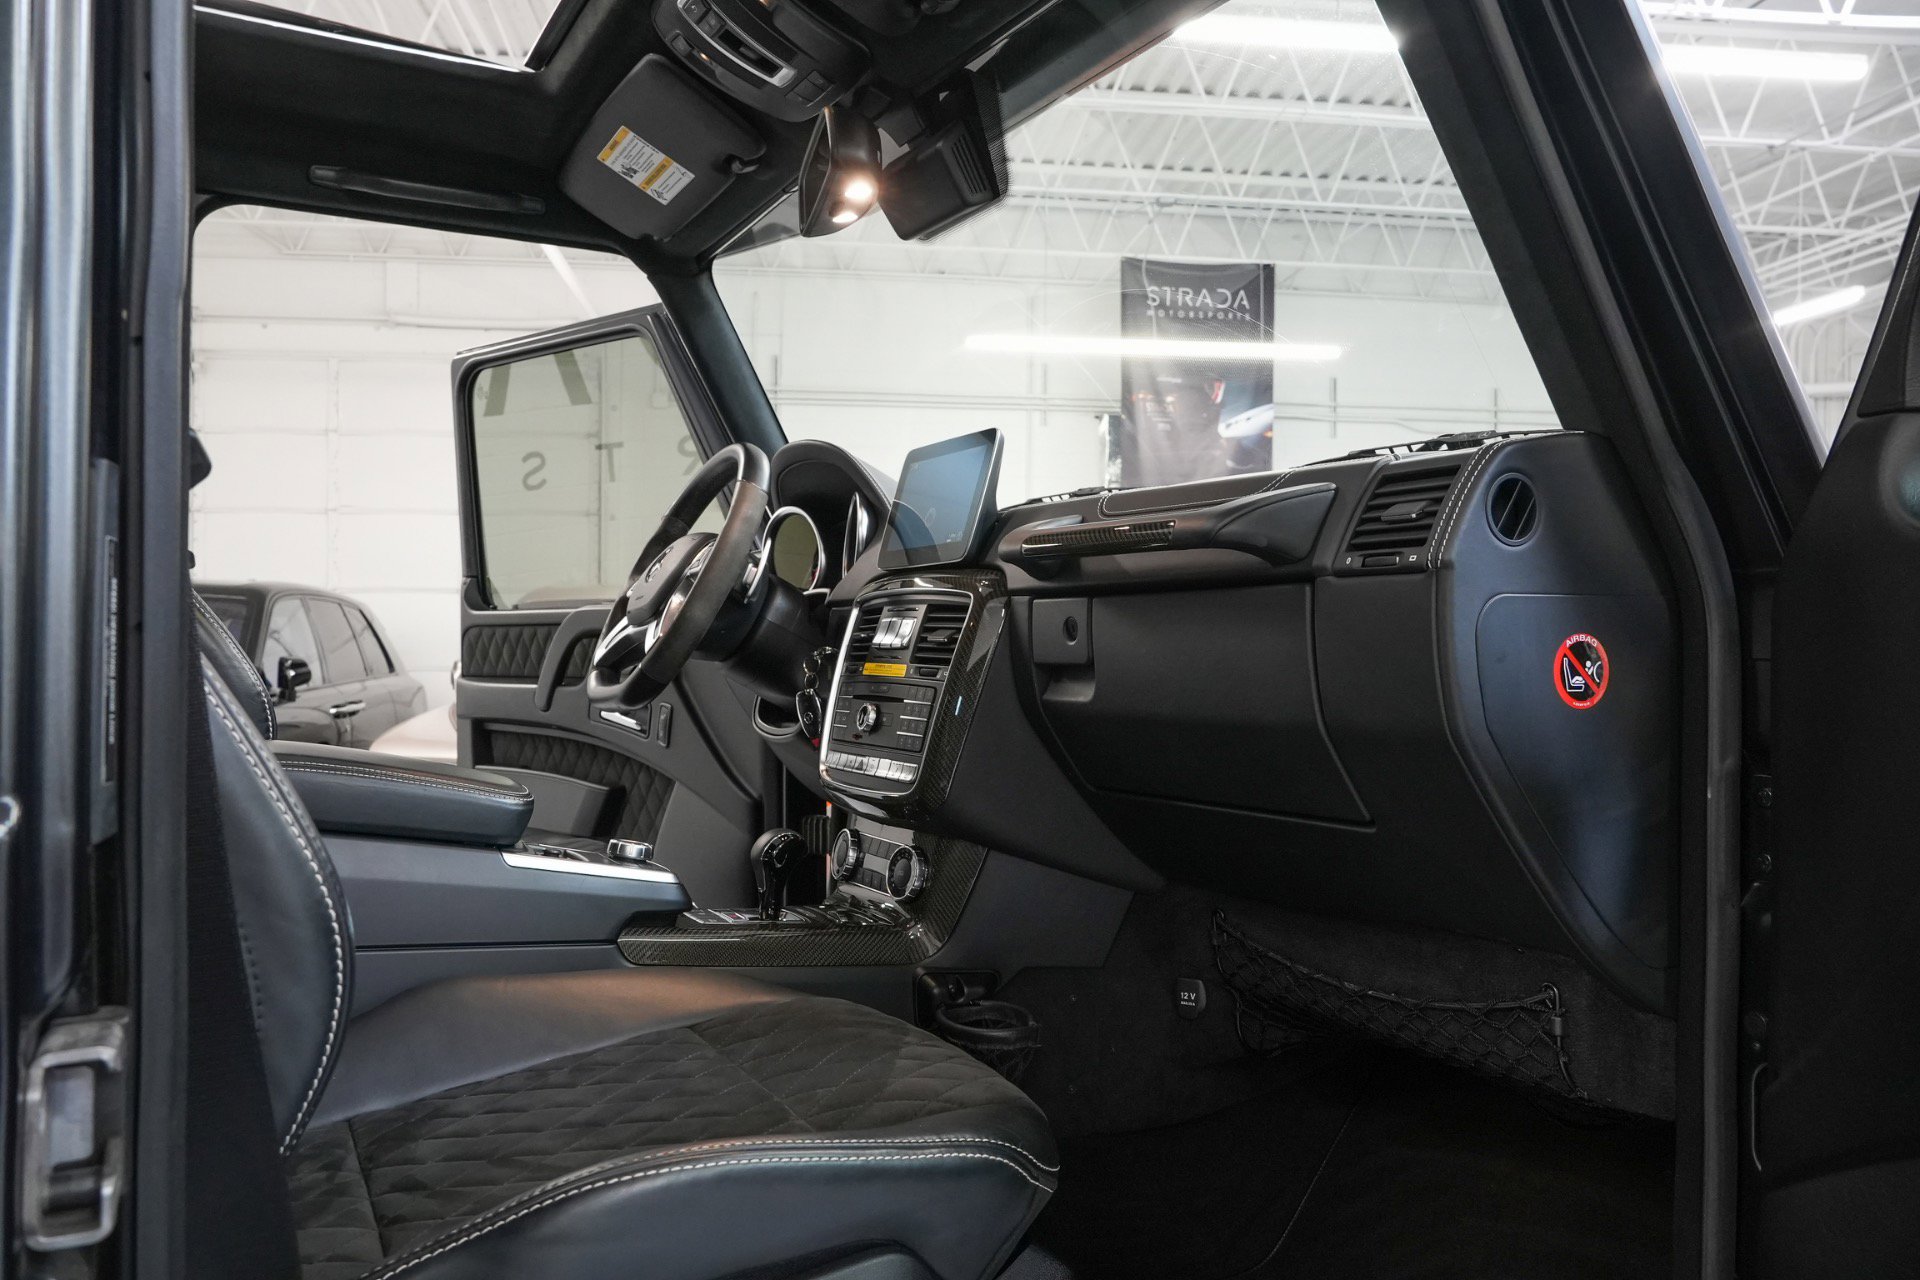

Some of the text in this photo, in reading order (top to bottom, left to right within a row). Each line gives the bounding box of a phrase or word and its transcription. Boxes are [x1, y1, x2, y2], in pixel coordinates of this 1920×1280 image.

[1146, 285, 1250, 310] STRADA
[1565, 634, 1599, 648] AIRBAG
[1180, 991, 1196, 1001] 12 V
